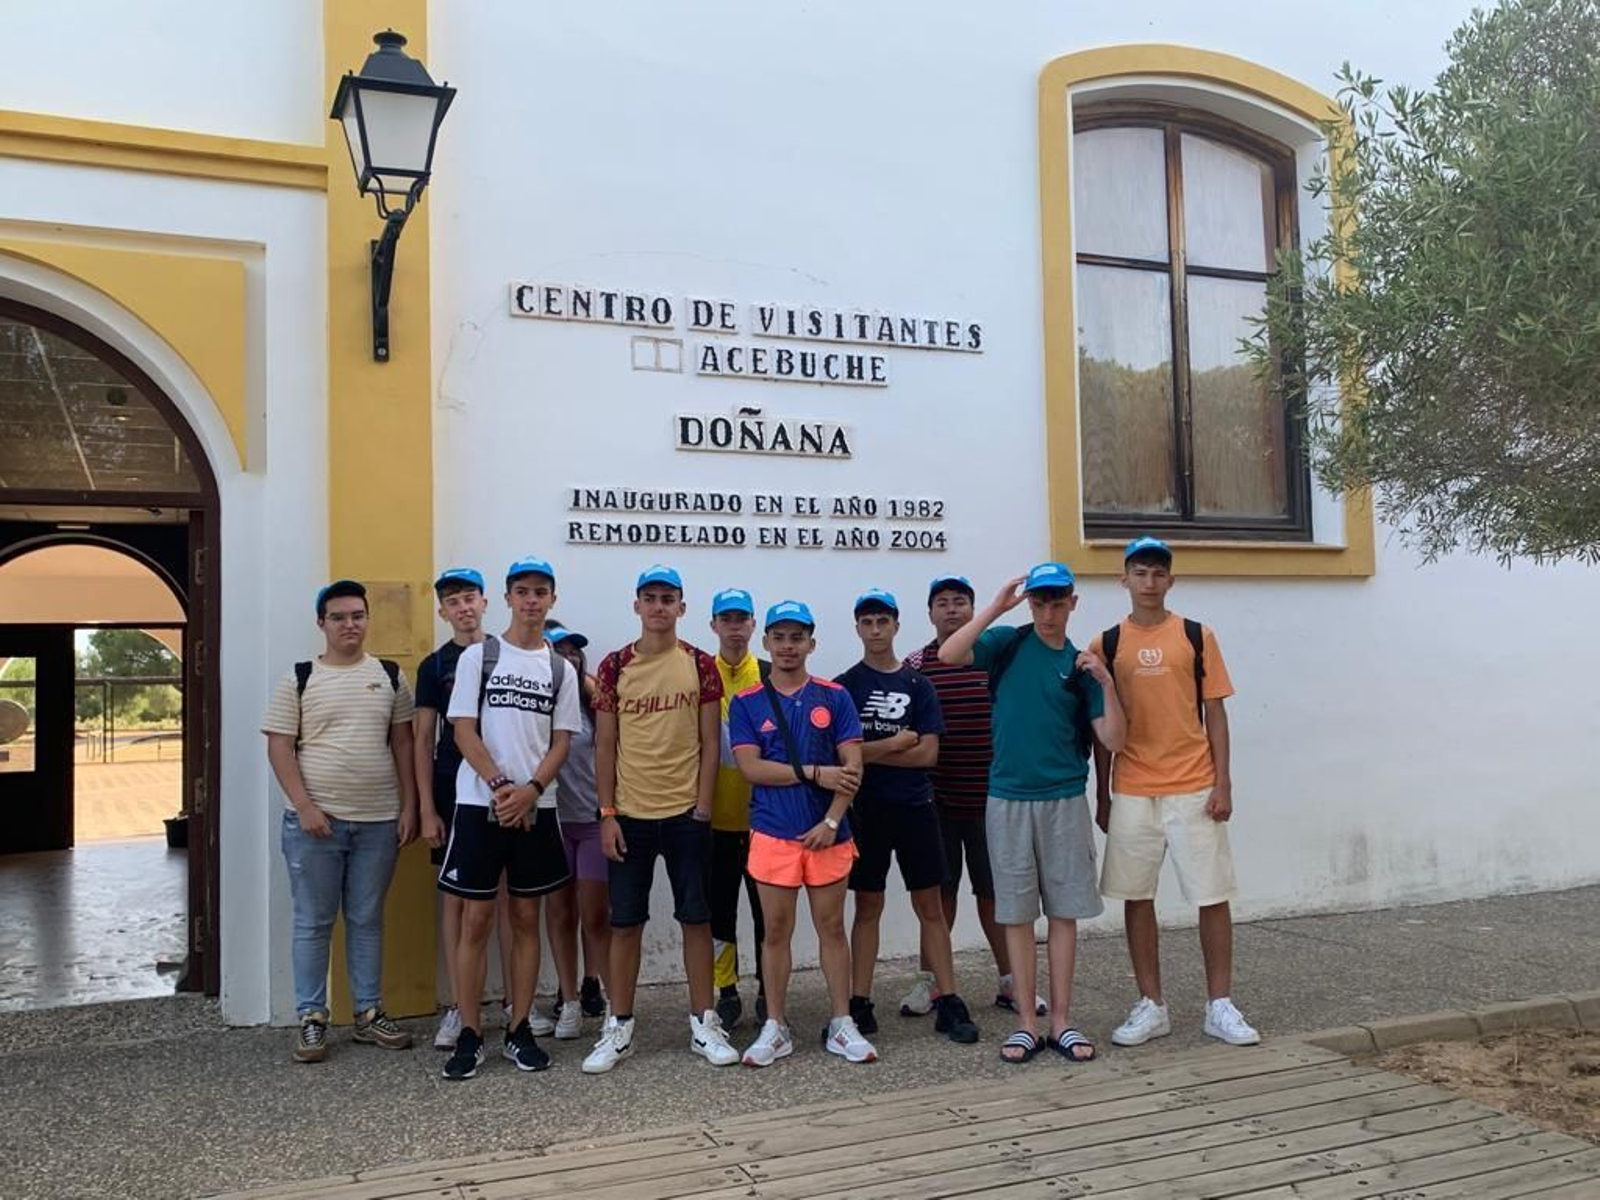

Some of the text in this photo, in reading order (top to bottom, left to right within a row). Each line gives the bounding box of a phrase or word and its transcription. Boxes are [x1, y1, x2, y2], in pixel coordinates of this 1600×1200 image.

[515, 285, 983, 349] CENTRO DE VISITANTES
[700, 345, 887, 381] ACEBUCHE
[679, 406, 851, 454] DOÑANA
[572, 488, 944, 518] INAUGURADO EN EL AÑO 1982
[568, 522, 948, 549] REMODELADO EN EL AÑO 2004
[491, 674, 540, 691] adidas
[489, 691, 538, 710] adidas
